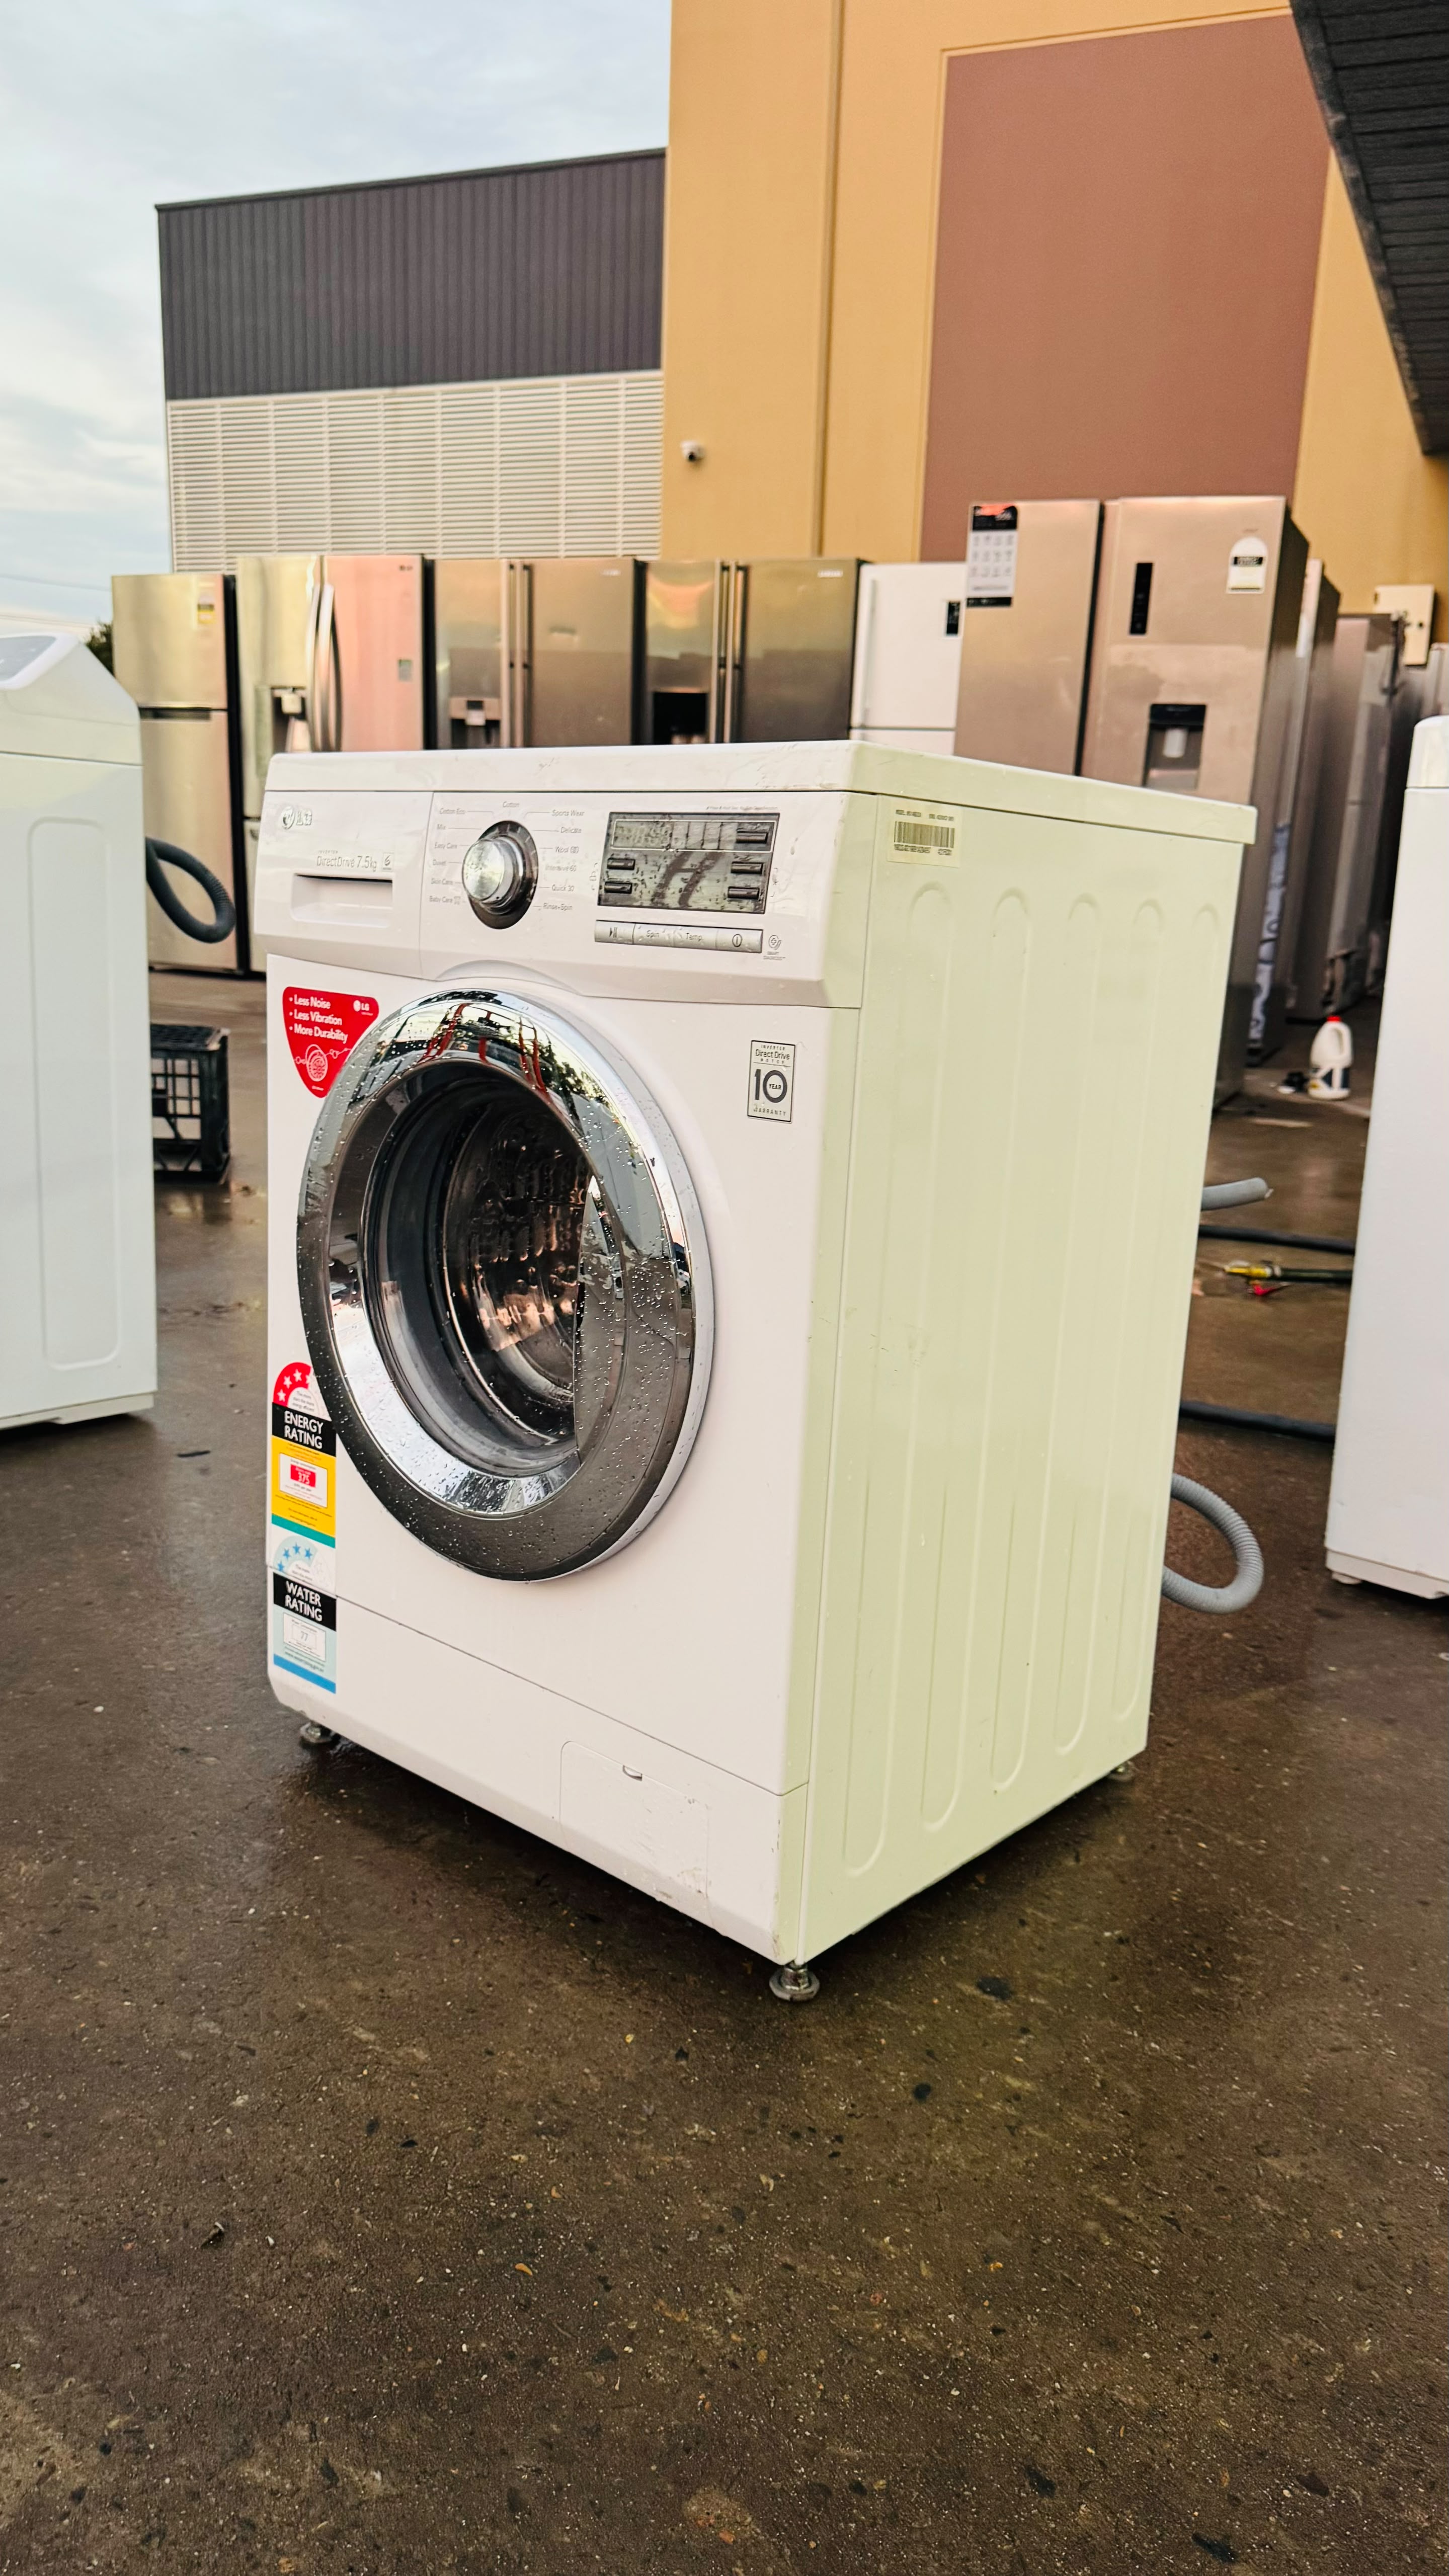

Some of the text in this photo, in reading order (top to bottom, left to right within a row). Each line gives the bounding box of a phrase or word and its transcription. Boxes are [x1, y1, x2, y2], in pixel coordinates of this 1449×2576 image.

[356, 855, 377, 872] 7.5kg
[294, 994, 331, 1009] Less Noise
[361, 1003, 370, 1011] LG
[294, 1009, 343, 1026] Less Vibration
[294, 1023, 348, 1044] More Durability
[755, 1049, 790, 1060] Direct Drive
[754, 1069, 788, 1103] 10
[753, 1107, 786, 1116] WARRANTY
[284, 1410, 324, 1435] ENERGY
[284, 1425, 323, 1450] RATING
[285, 1580, 321, 1607] WATER
[285, 1594, 323, 1622] RATING
